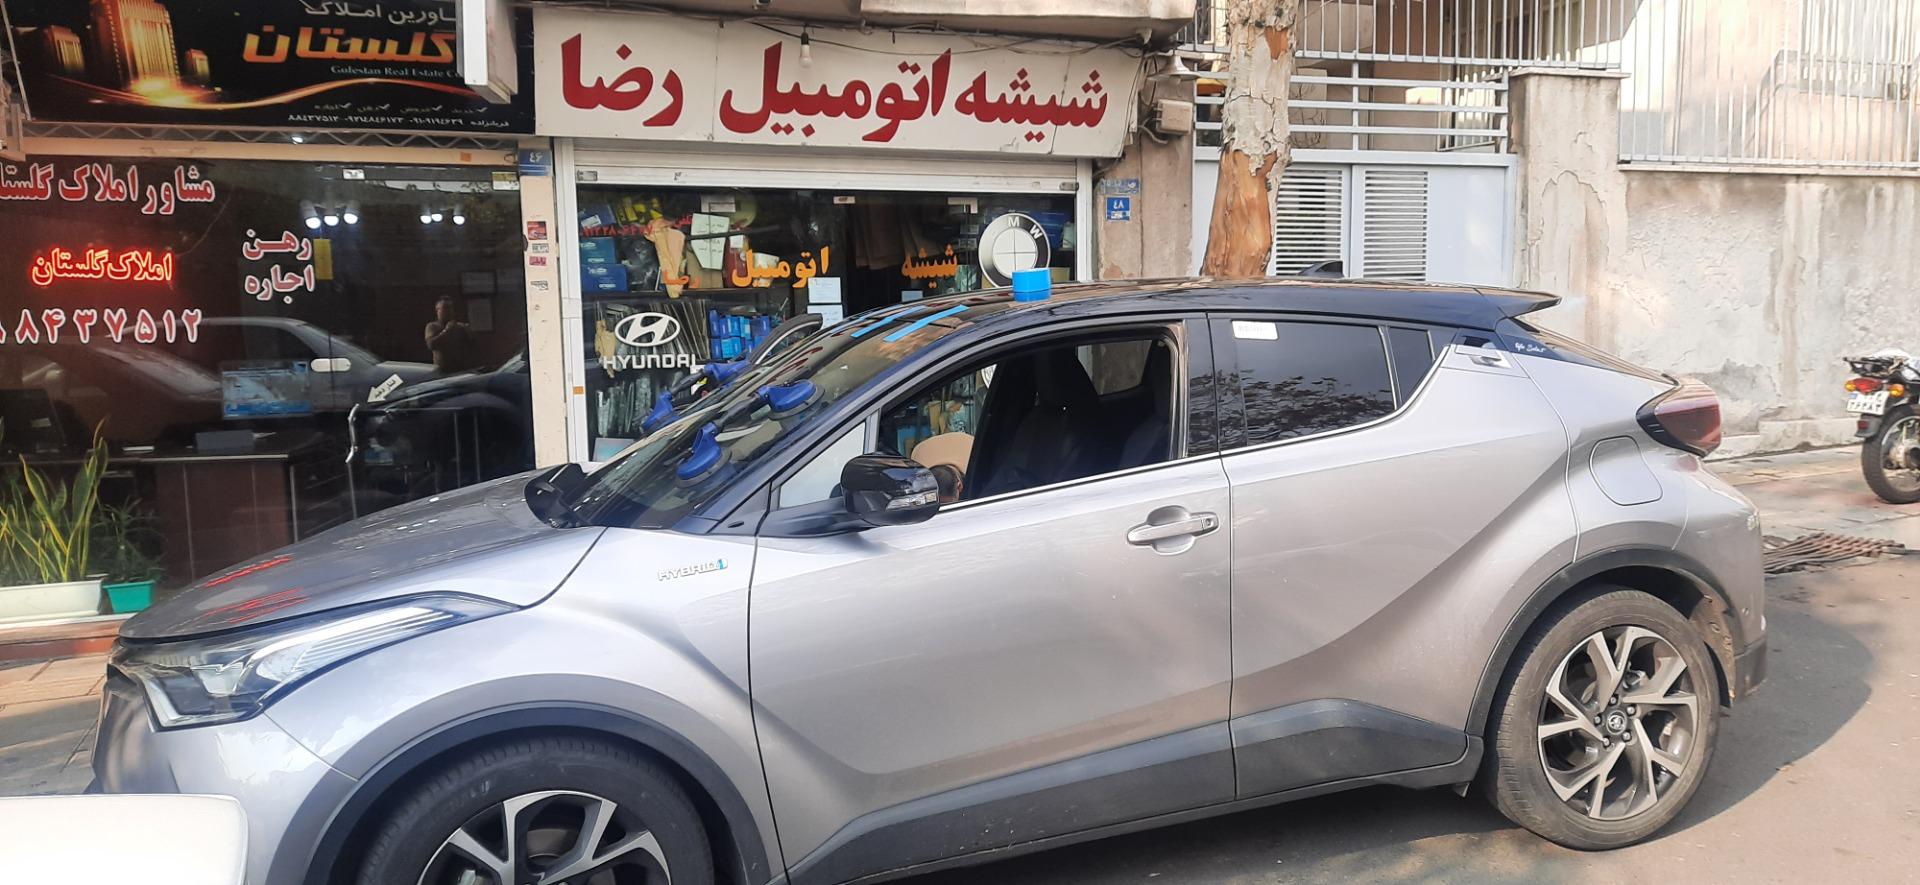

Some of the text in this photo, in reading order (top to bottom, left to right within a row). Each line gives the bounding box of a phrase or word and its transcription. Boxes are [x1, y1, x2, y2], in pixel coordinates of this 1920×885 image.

[303, 1, 457, 26] اورین املاک
[242, 24, 457, 64] گلستان
[385, 67, 409, 76] Real
[412, 68, 444, 78] Estate
[561, 33, 1109, 143] شیشه اتومبیل رضا
[288, 113, 339, 123] ۸۸۴۳۷۵۱۲
[58, 163, 139, 202] املاک
[141, 165, 216, 215] مشاور
[1113, 199, 1125, 210] ۴۸
[242, 228, 313, 261] رهن
[32, 248, 173, 286] املاک گلستان
[244, 264, 316, 305] اجاره
[731, 245, 831, 289] اتومبیل
[901, 243, 959, 290] شیشه
[0, 308, 203, 345] ۸۴۳۷۵۱۲
[603, 353, 697, 370] HYUNDAI
[657, 562, 716, 582] HYBRID
